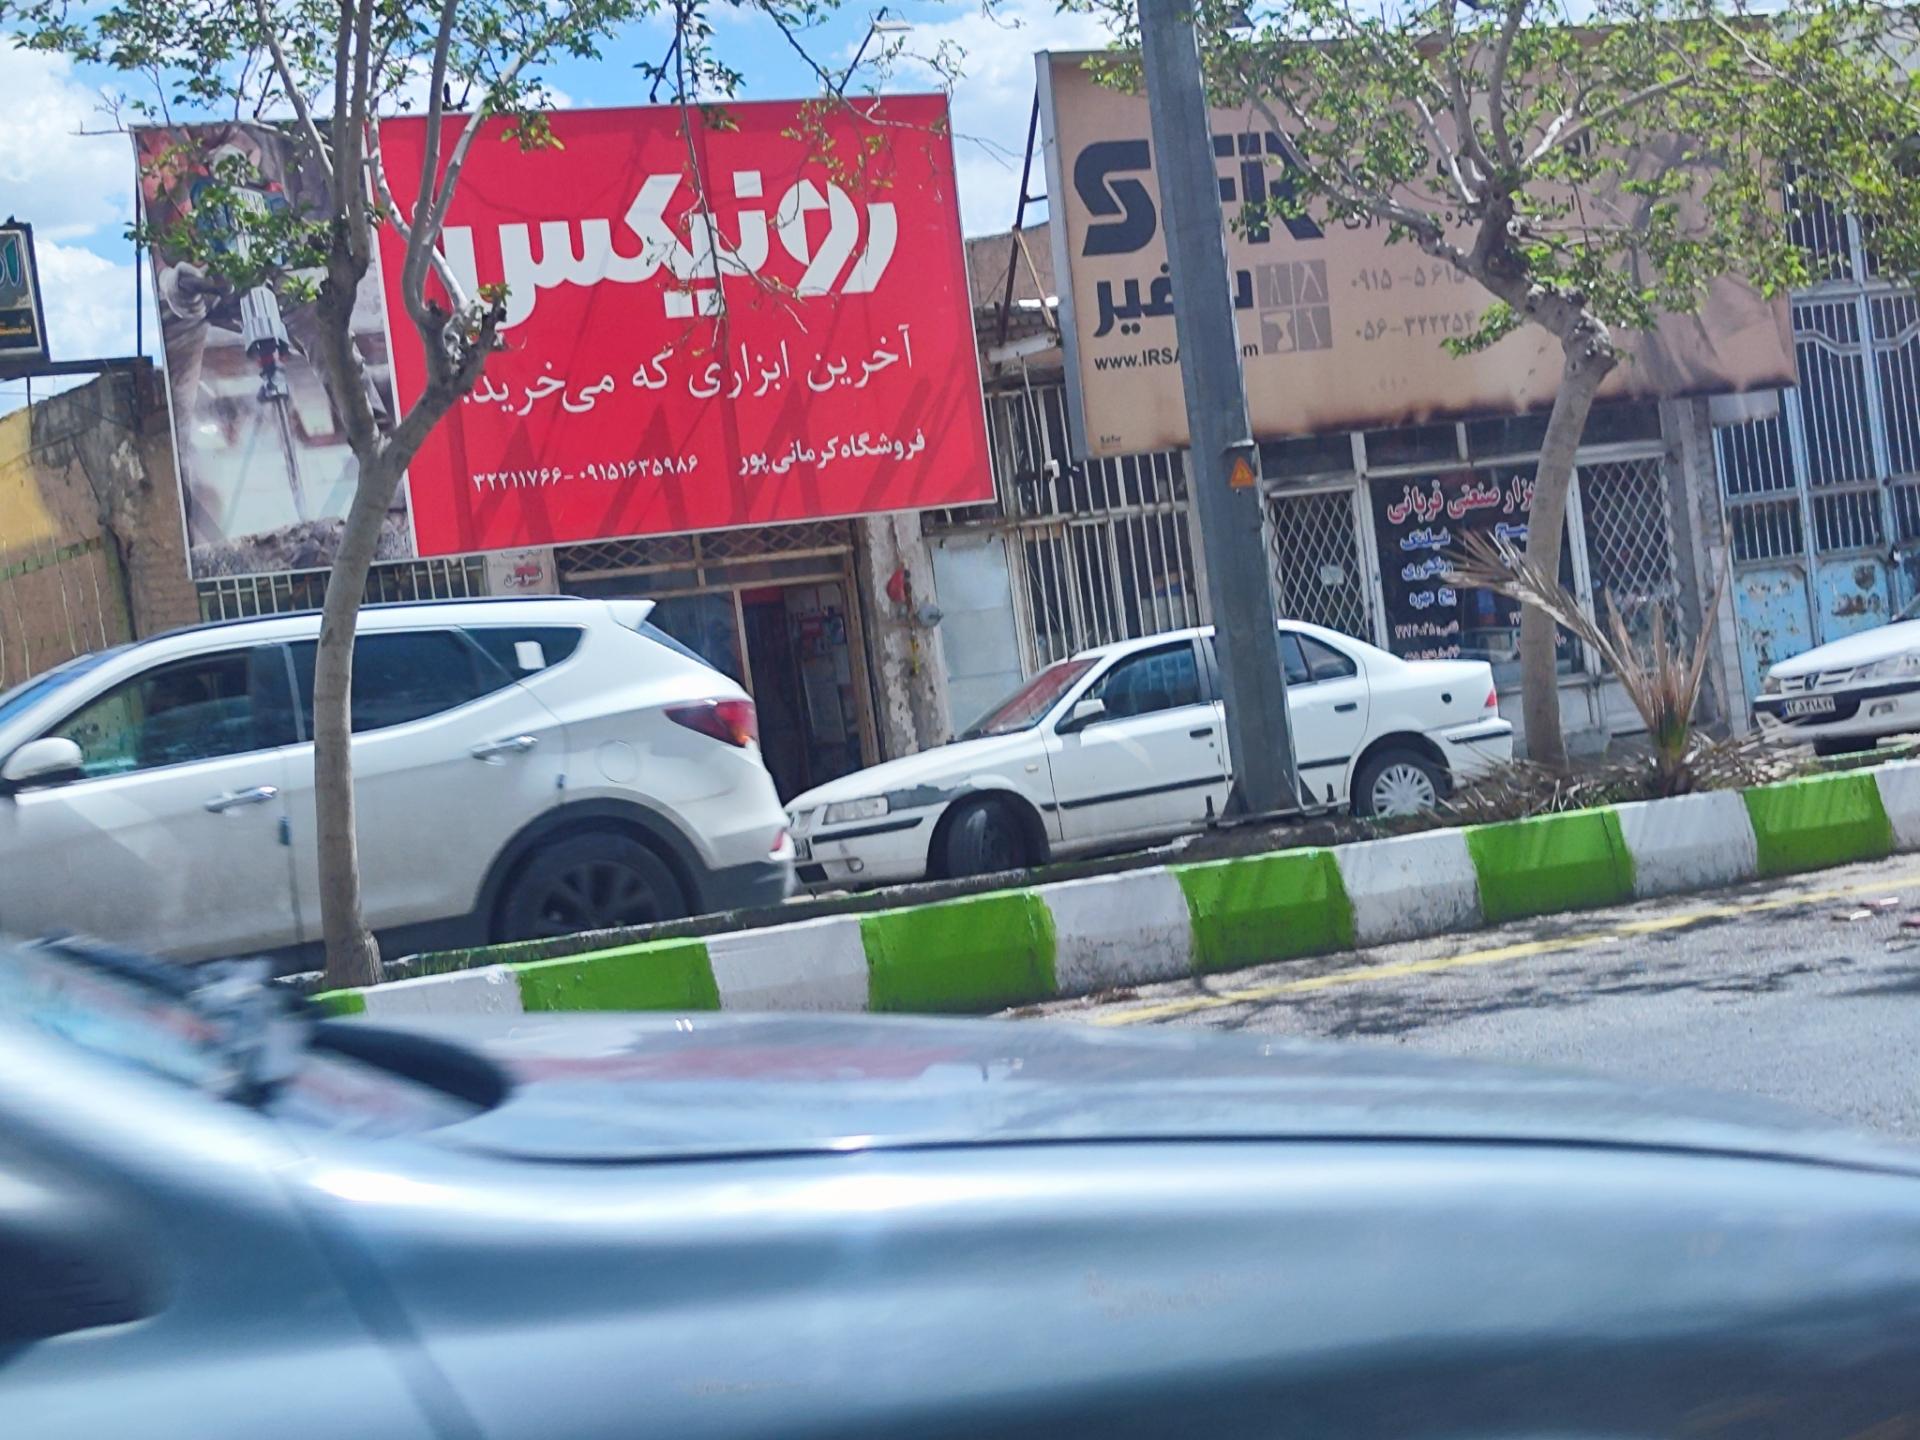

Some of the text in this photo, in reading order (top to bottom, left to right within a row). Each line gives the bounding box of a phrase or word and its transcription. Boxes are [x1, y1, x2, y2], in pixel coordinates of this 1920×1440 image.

[442, 170, 898, 330] رونیکس
[632, 349, 675, 391] که
[689, 341, 790, 399] ابزاری
[806, 325, 912, 392] آخرین
[840, 427, 926, 461] فروشگاه
[1387, 479, 1444, 524] قربانی
[1447, 481, 1501, 519] صنعتی
